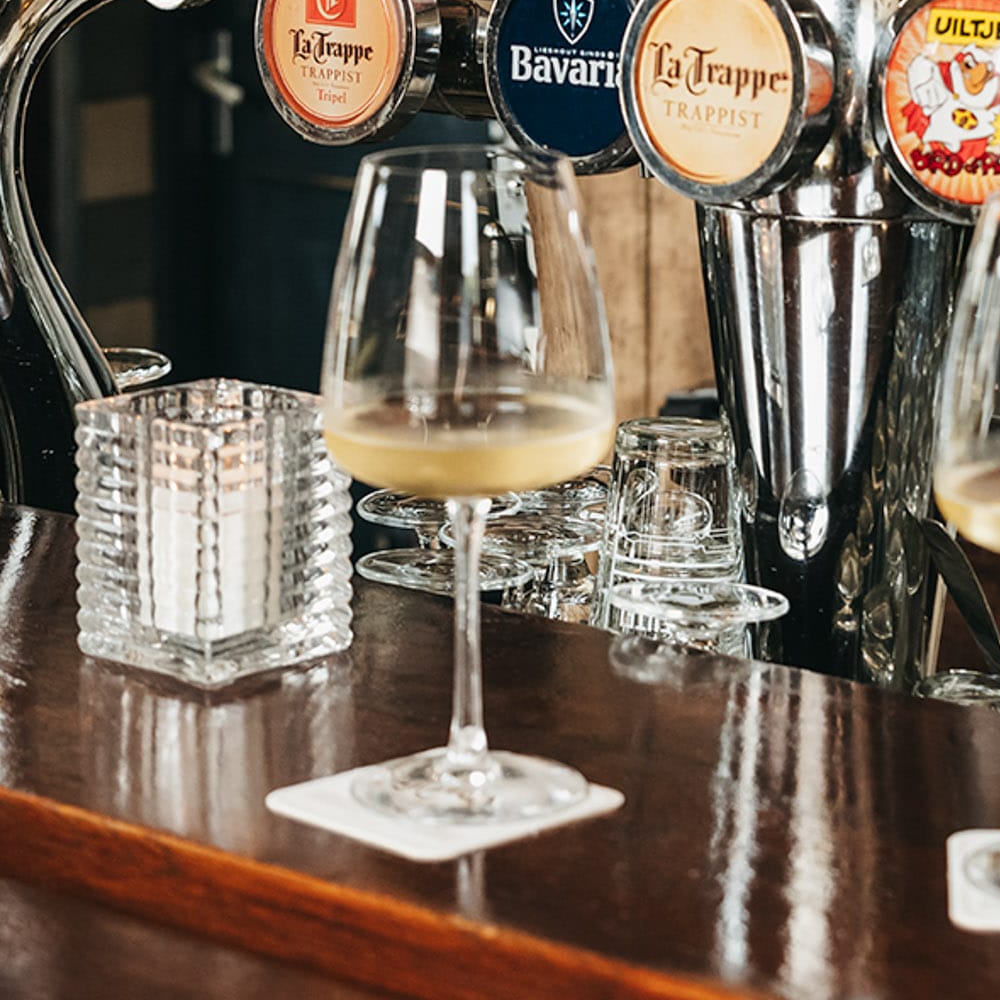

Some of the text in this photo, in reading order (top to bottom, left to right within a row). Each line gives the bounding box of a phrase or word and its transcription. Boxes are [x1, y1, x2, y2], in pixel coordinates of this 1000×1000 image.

[288, 28, 375, 66] La Trappe
[301, 65, 363, 84] TRAPPIST
[648, 42, 789, 100] La Trappe
[316, 88, 348, 105] Tripel
[664, 99, 763, 130] TRAPPIST
